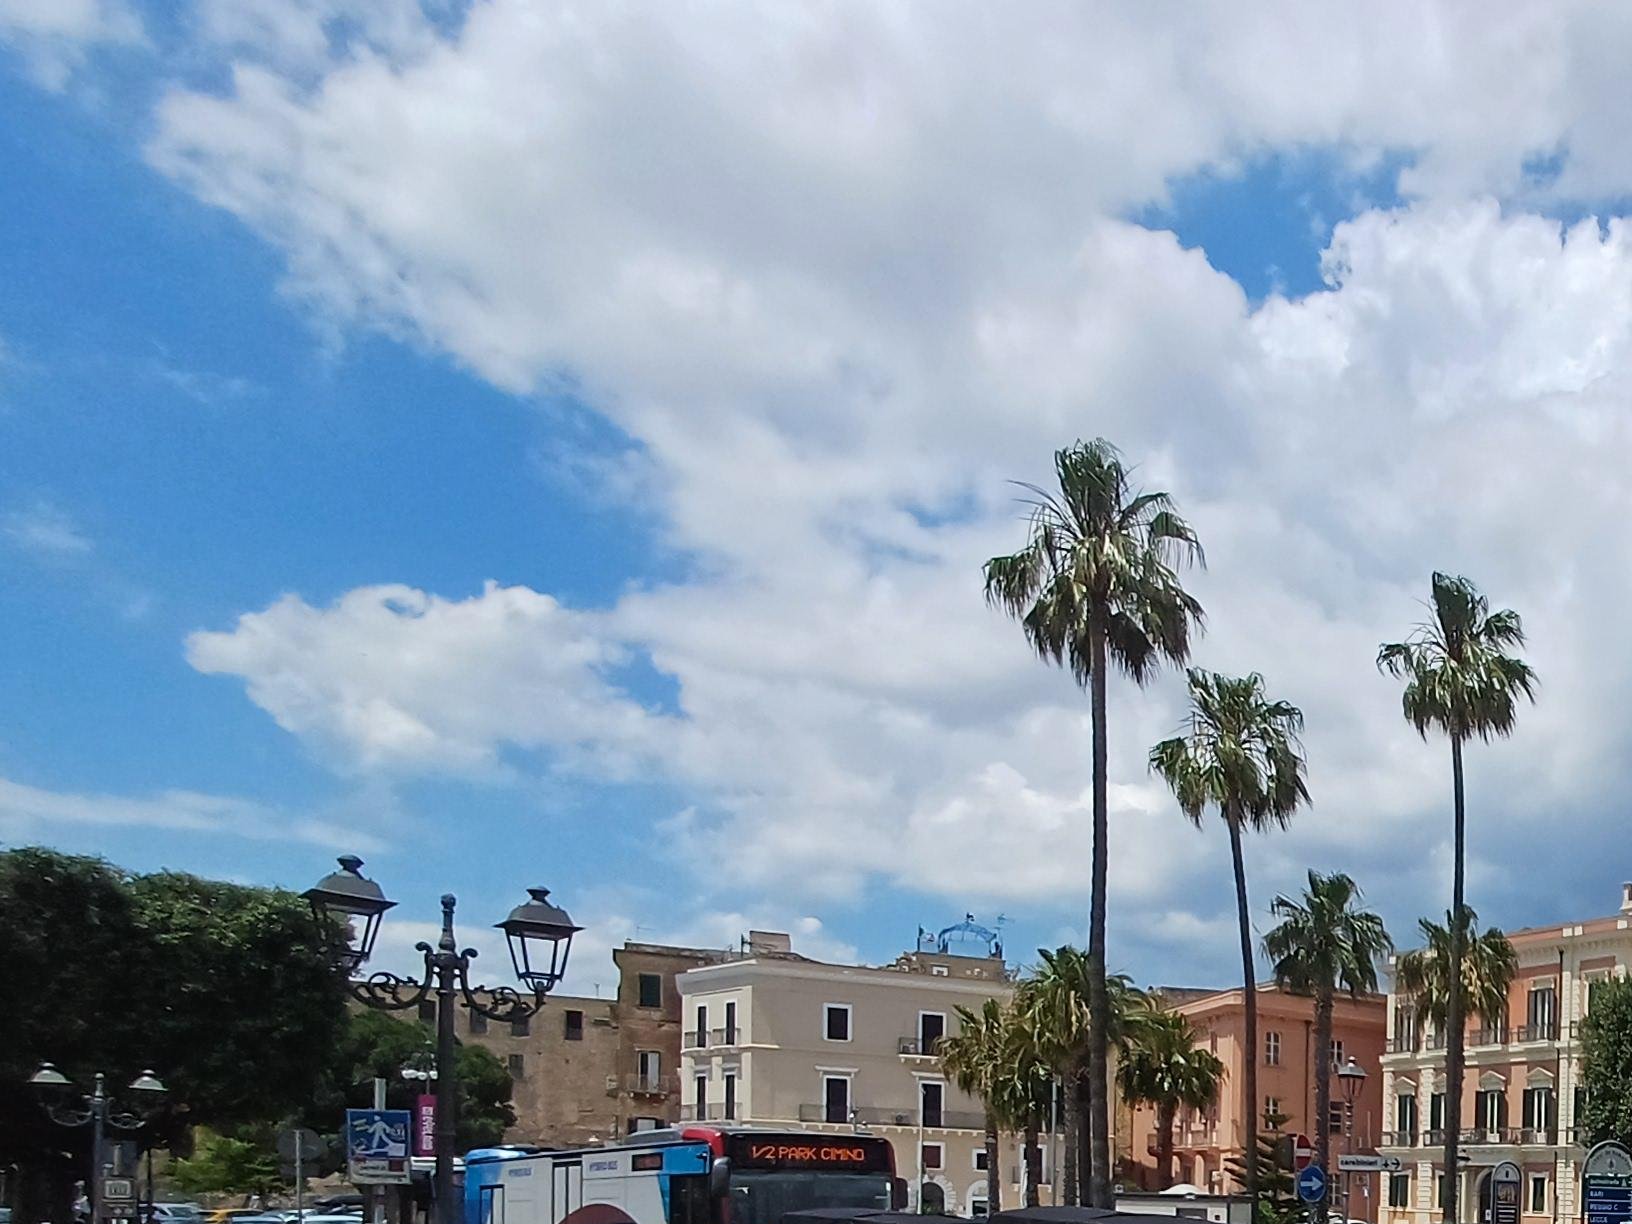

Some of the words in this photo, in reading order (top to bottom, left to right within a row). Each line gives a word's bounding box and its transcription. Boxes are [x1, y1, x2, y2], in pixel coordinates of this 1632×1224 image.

[778, 1146, 817, 1160] PARK
[820, 1147, 865, 1161] CIMINO
[1589, 1190, 1605, 1198] BARI
